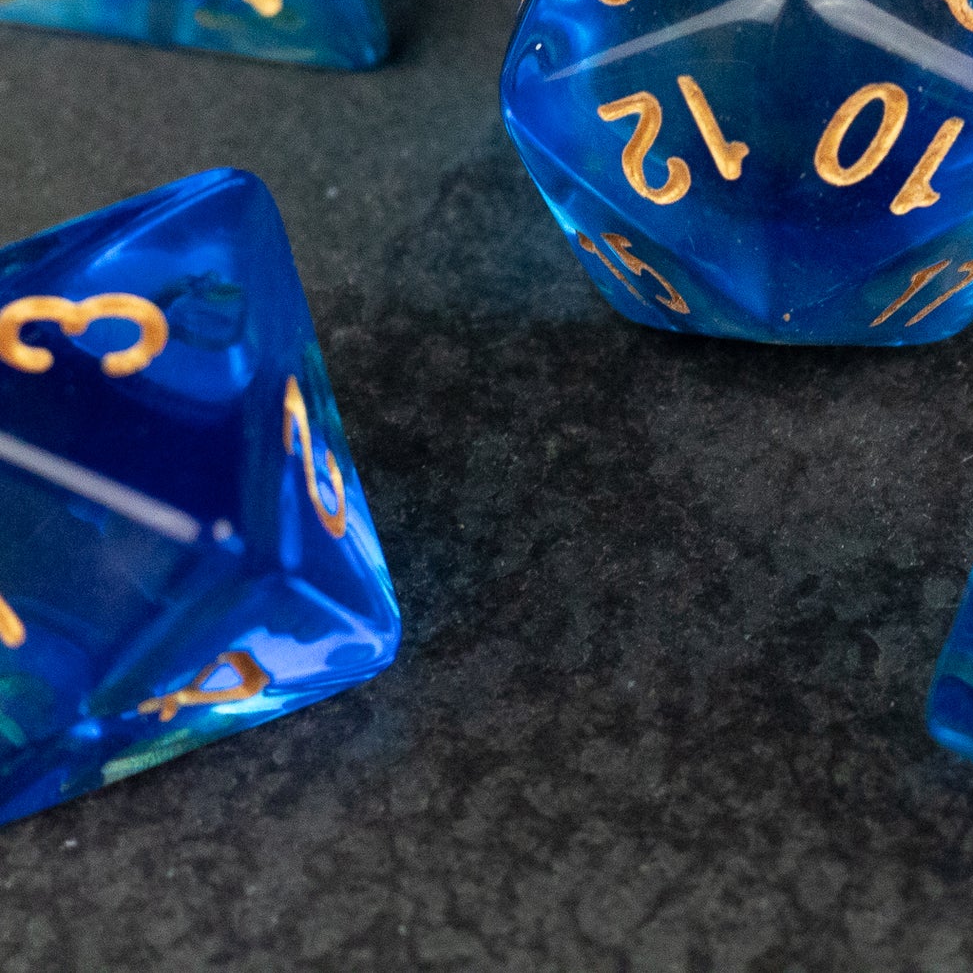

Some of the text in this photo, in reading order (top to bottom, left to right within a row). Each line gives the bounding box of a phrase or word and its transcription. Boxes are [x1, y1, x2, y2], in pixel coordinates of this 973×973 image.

[597, 74, 749, 206] 12
[813, 81, 965, 215] 10
[0, 292, 169, 377] 3
